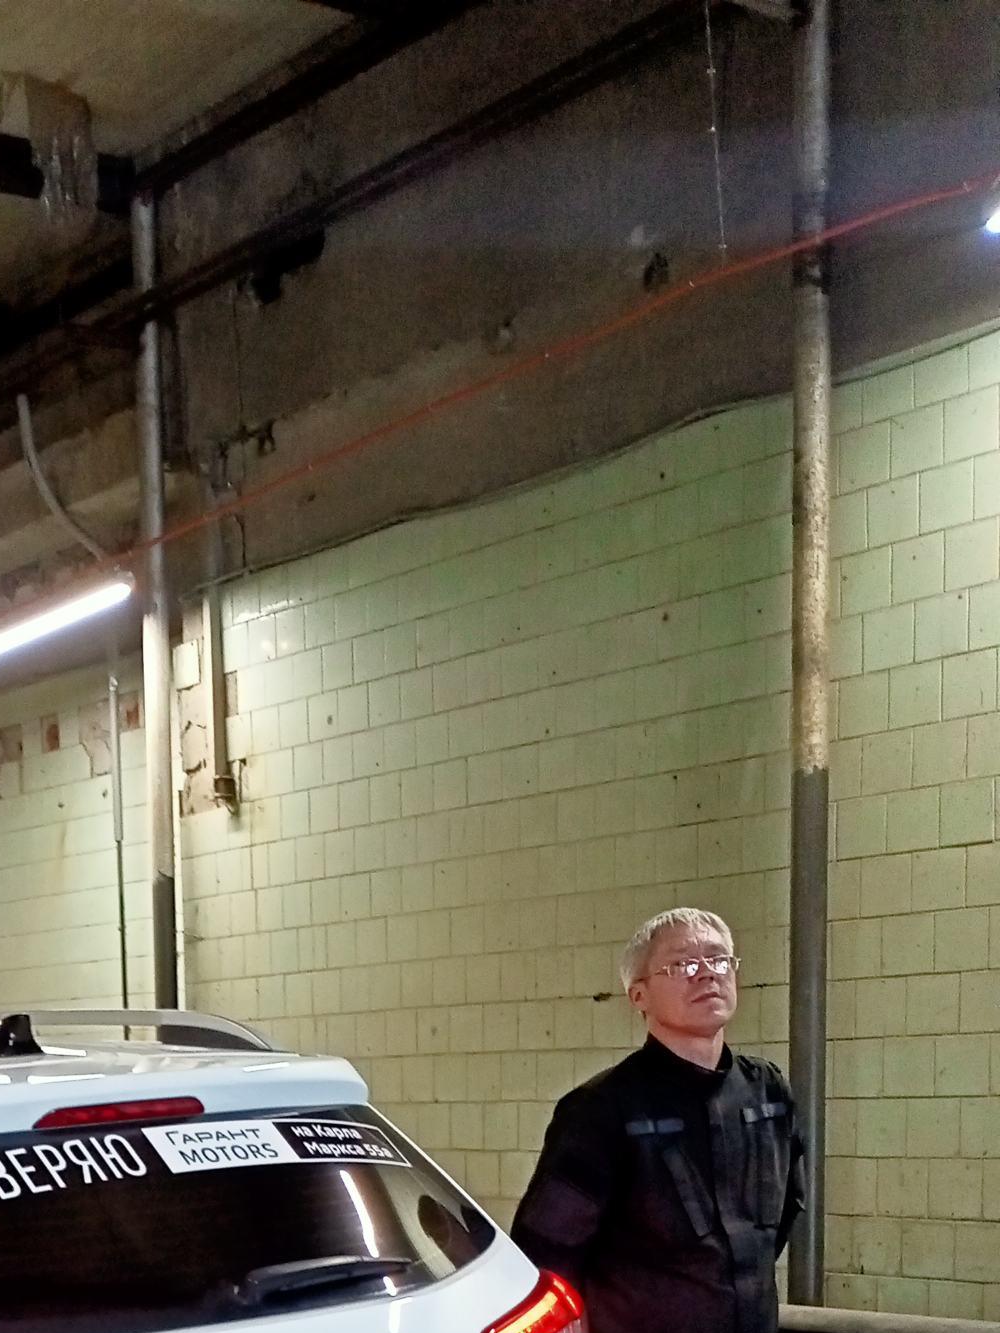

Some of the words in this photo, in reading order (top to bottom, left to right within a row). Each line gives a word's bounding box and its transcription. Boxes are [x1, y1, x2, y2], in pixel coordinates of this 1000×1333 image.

[315, 1124, 361, 1141] Карла
[179, 1143, 279, 1165] MOTORS
[303, 1142, 366, 1158] Маркса
